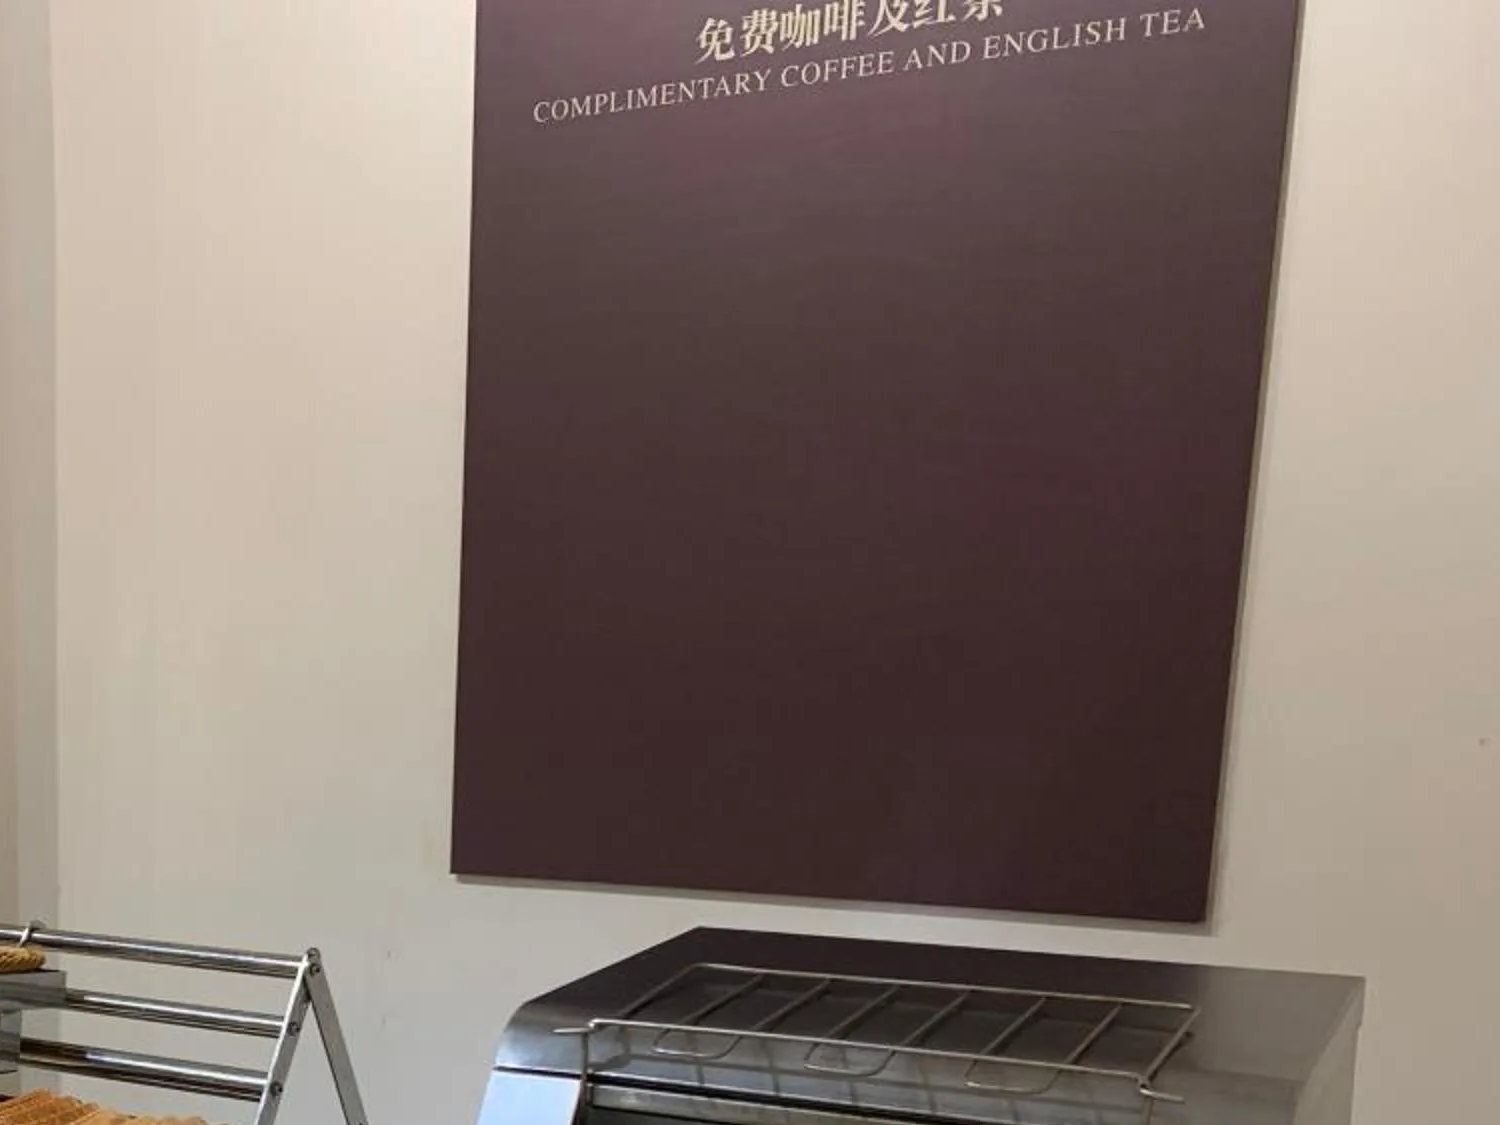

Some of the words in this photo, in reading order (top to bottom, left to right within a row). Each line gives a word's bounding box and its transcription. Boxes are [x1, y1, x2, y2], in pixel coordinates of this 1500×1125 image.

[532, 68, 772, 124] COMPLIMENTARY
[780, 50, 896, 88] COFFEE
[902, 40, 972, 72] AND
[982, 17, 1127, 61] ENGLISH
[1139, 7, 1206, 38] TEA
